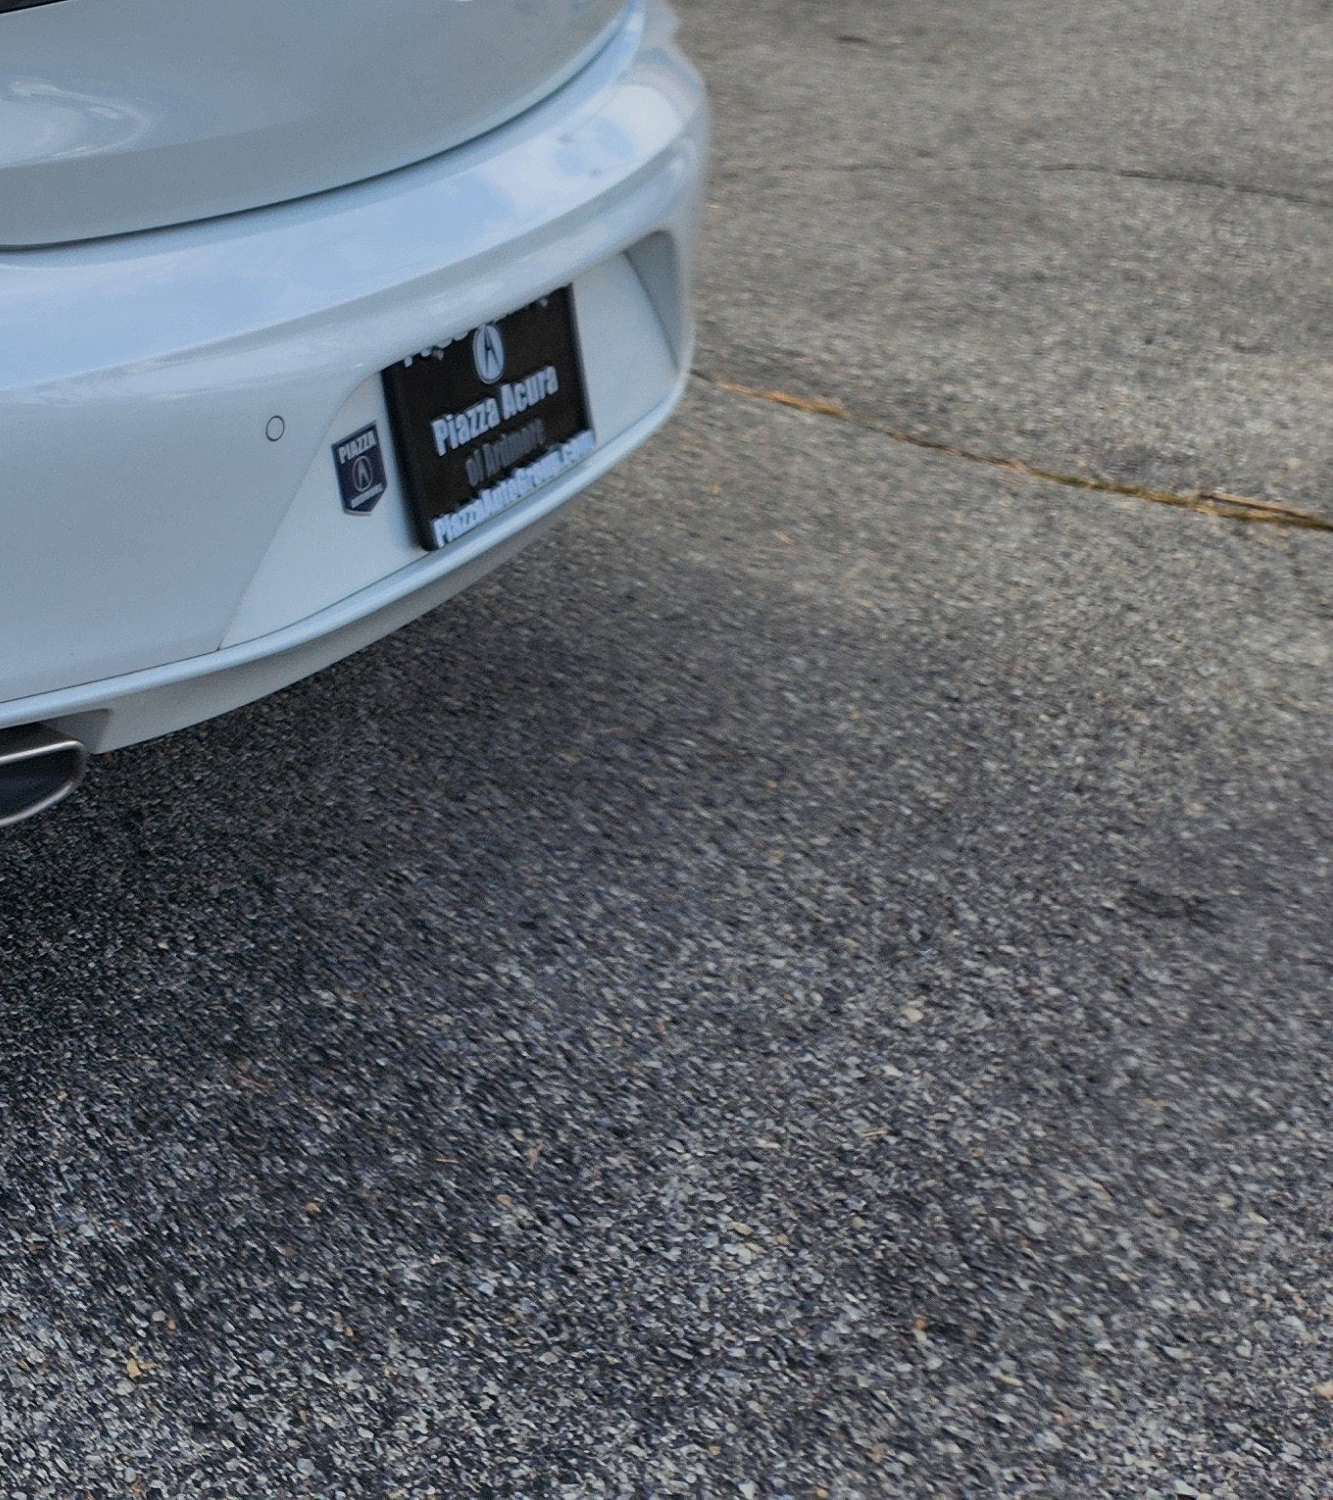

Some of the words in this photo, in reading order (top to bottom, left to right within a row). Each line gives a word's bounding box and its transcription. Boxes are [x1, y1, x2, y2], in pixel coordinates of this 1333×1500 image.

[431, 397, 502, 457] Piazza
[500, 365, 559, 421] Acura
[338, 430, 377, 465] PIAZZA
